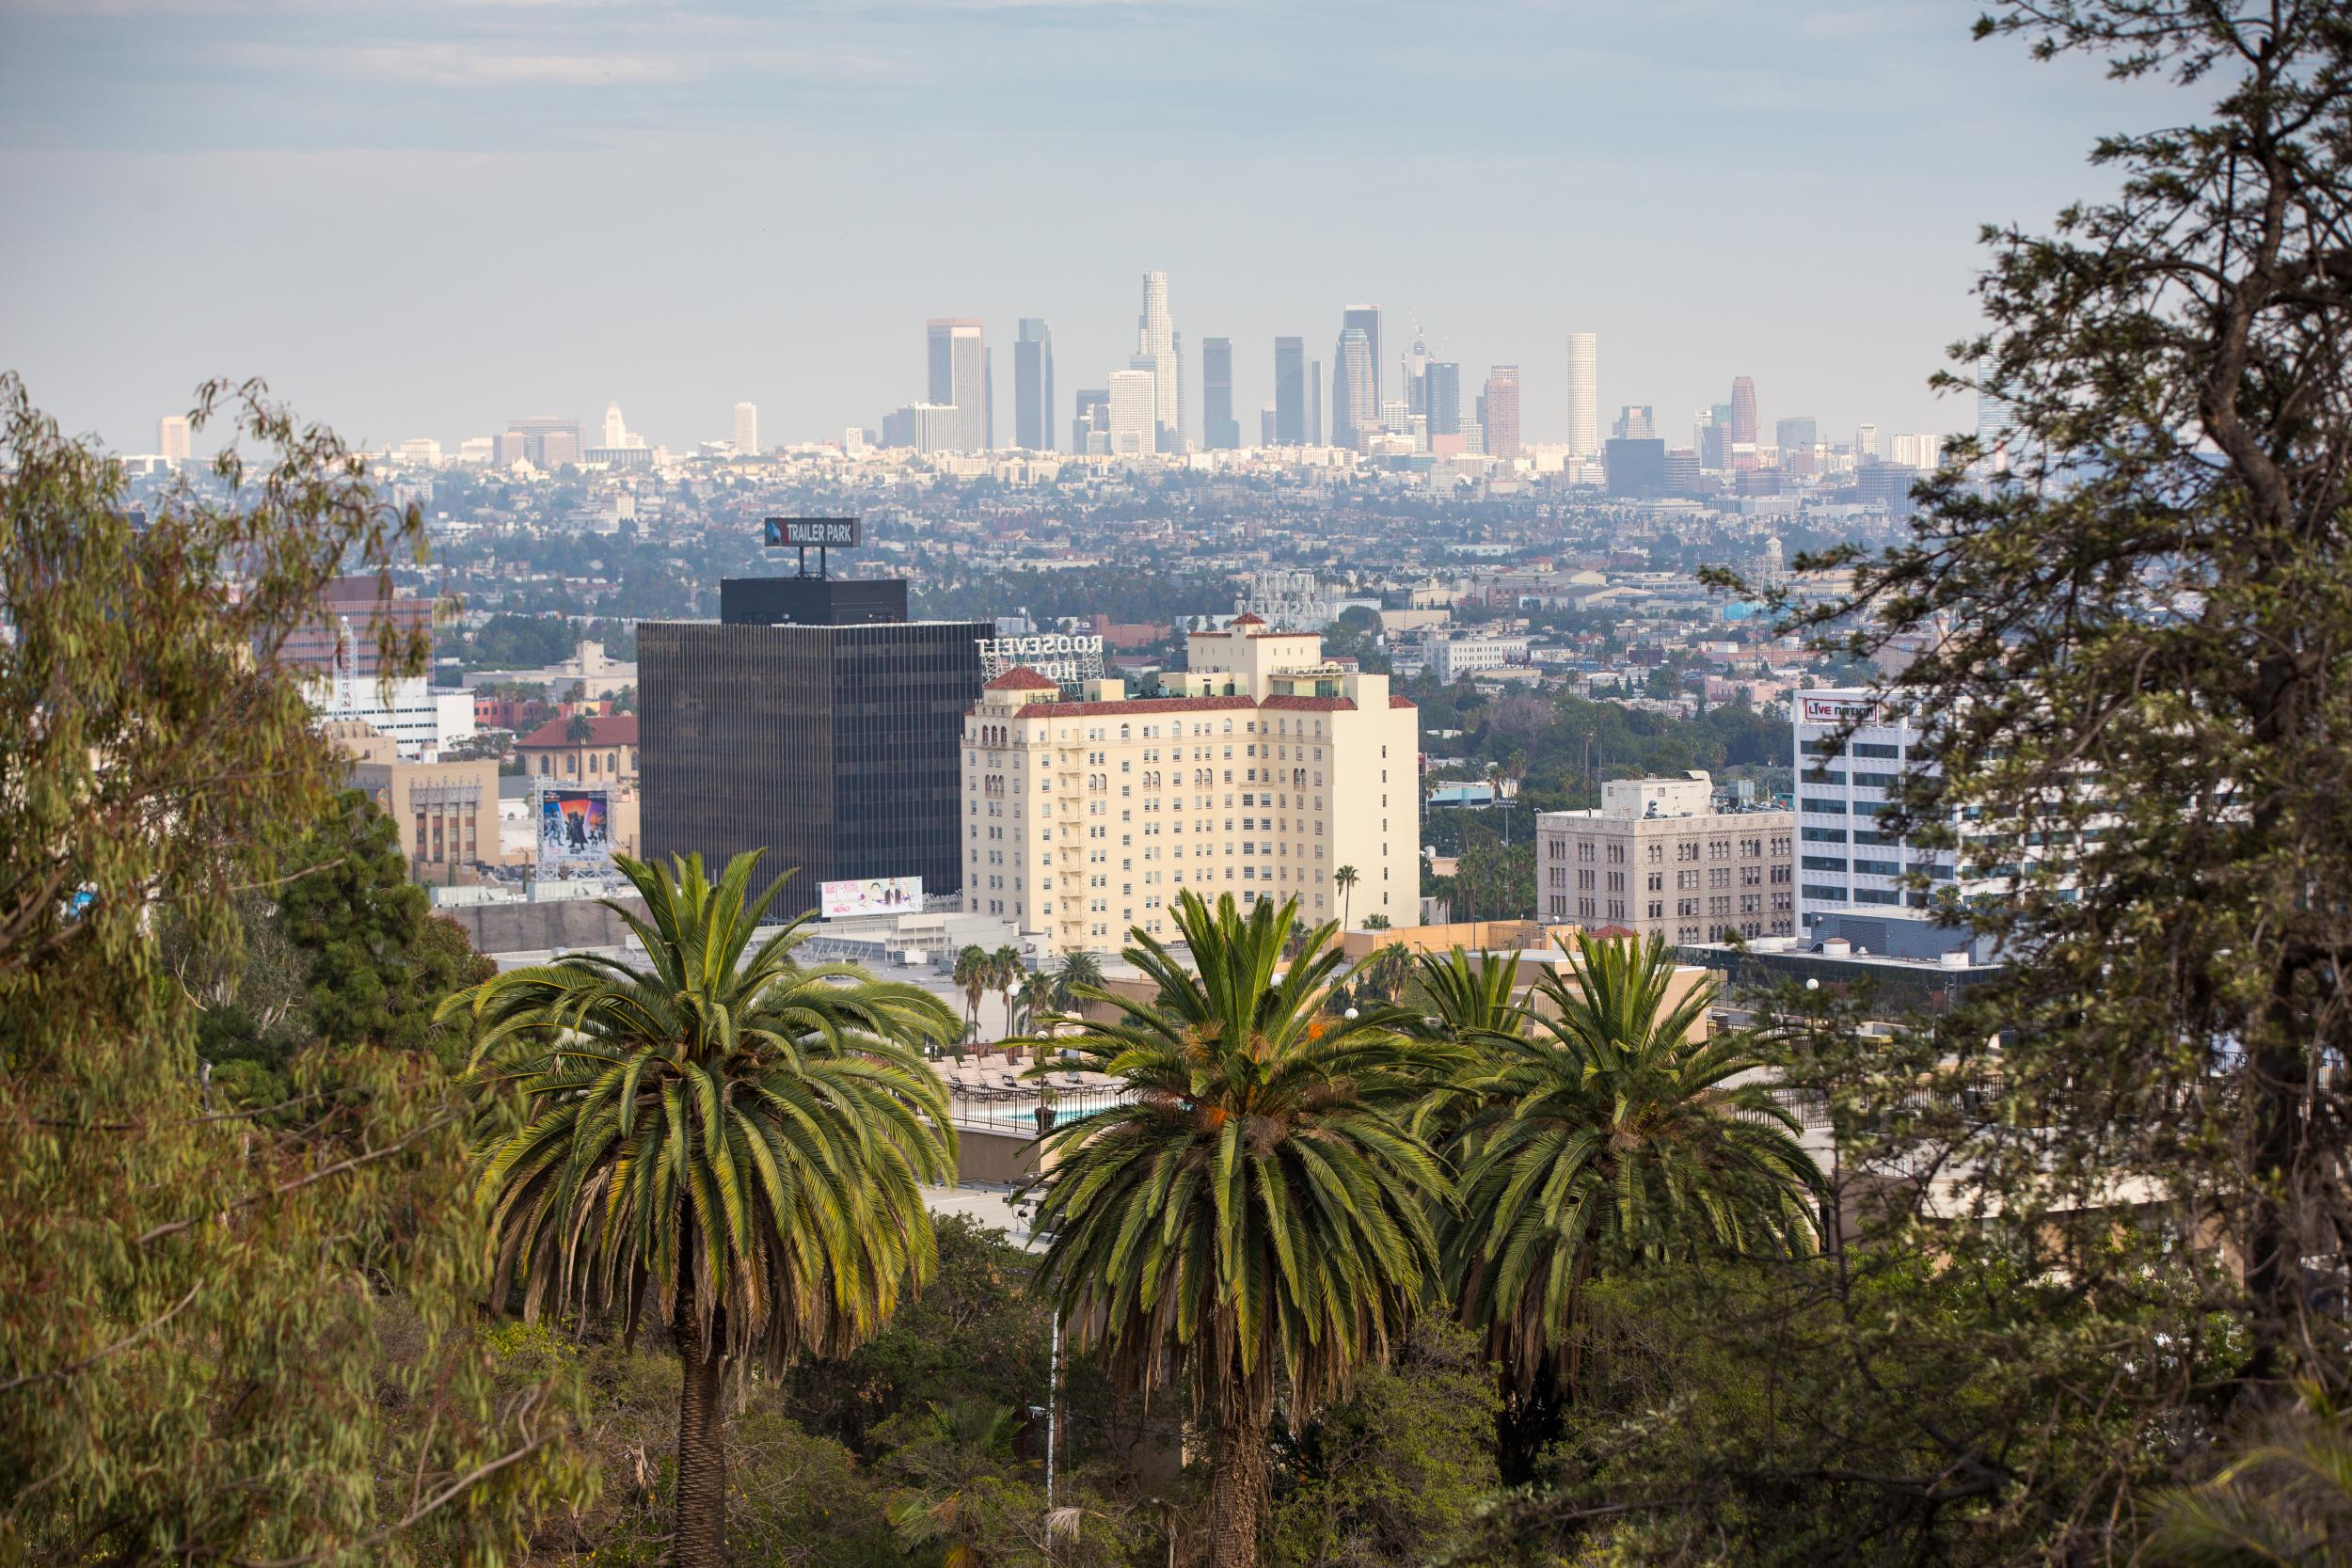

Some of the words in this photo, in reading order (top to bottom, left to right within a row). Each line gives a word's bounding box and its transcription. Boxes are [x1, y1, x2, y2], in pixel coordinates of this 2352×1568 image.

[787, 524, 825, 542] TRAILER
[827, 524, 851, 543] PARK
[1808, 702, 1831, 715] LIVE
